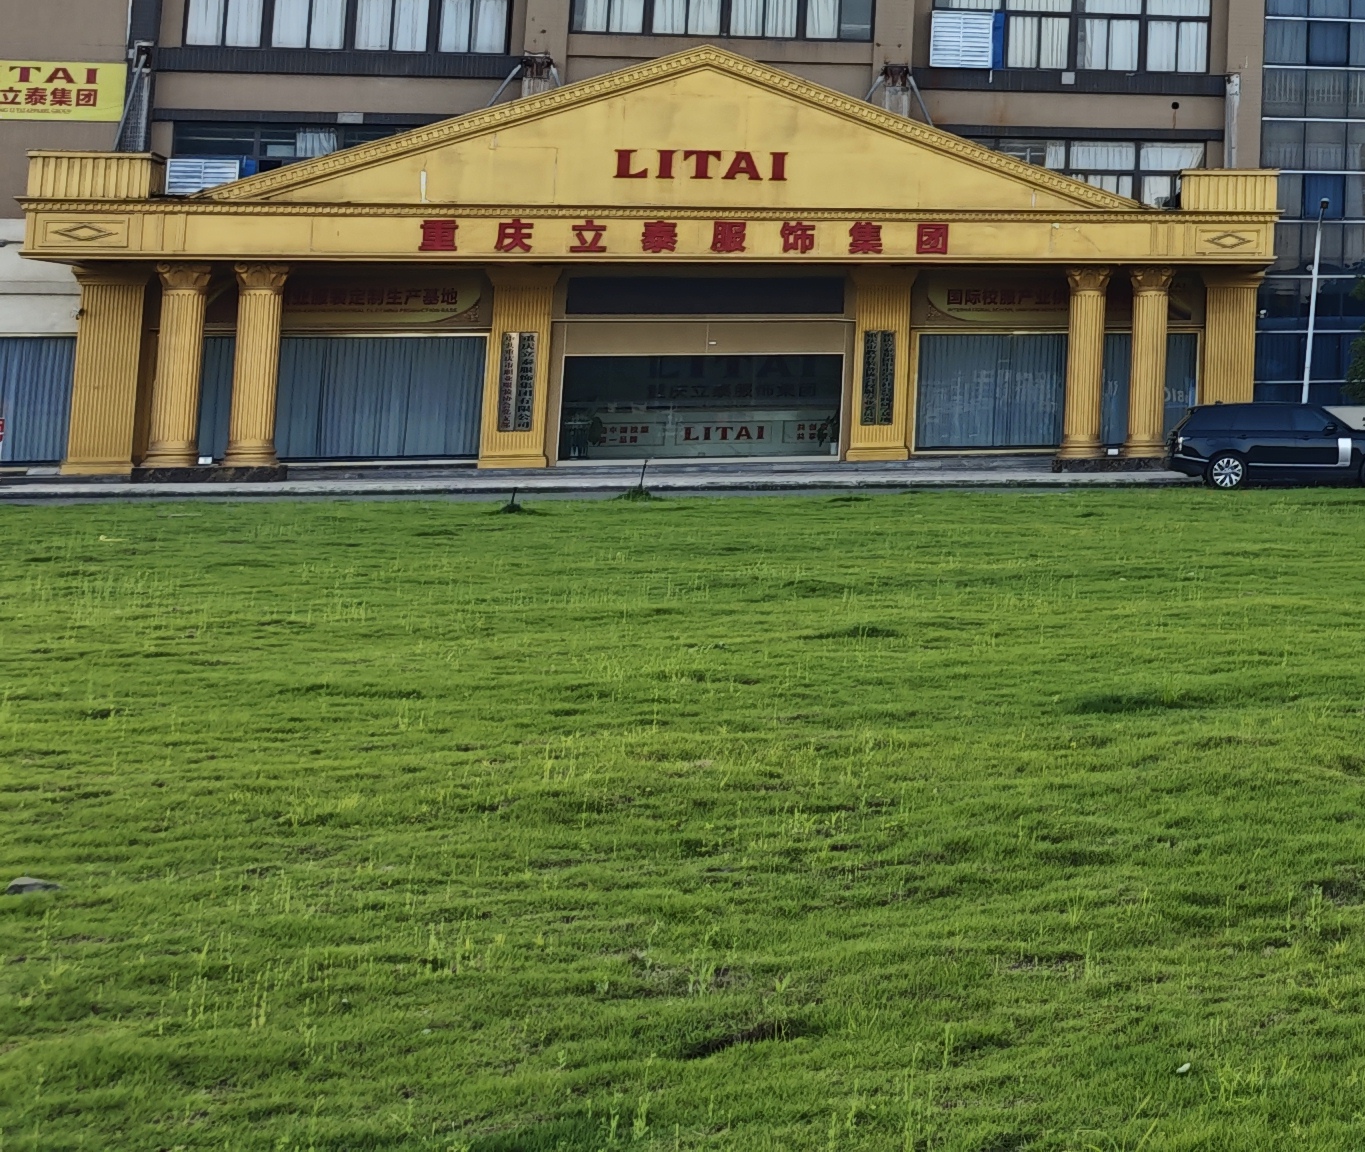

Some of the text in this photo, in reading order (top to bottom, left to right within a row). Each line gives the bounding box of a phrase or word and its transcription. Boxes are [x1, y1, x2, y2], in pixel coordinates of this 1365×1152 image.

[0, 87, 98, 107] 立泰集团
[613, 149, 789, 181] LITAI
[419, 219, 949, 255] 重庆立泰服饰集团
[683, 426, 765, 441] LITAI
